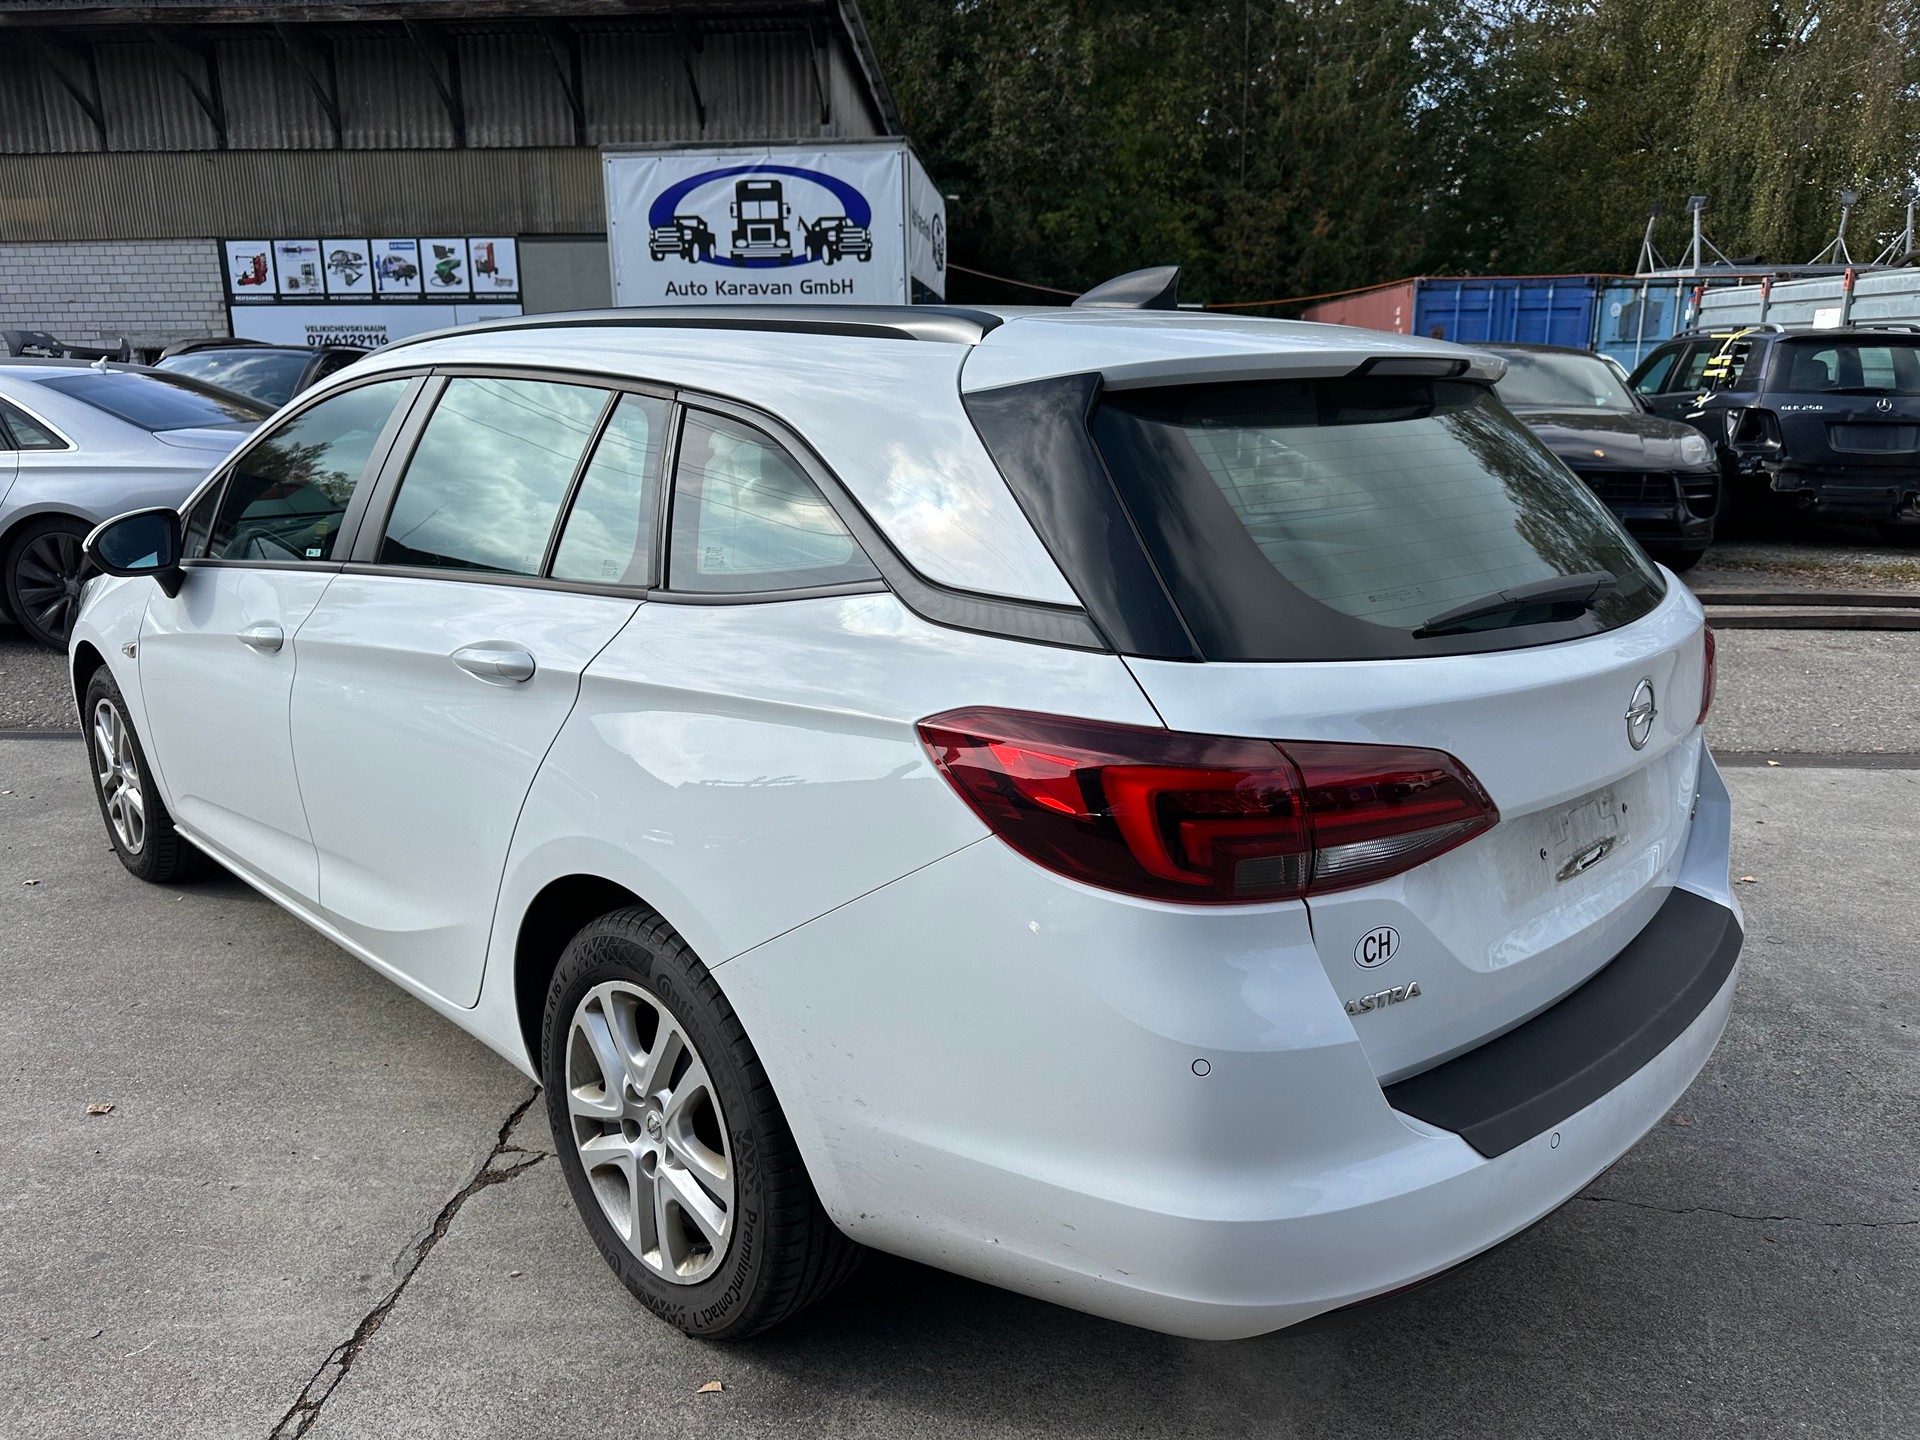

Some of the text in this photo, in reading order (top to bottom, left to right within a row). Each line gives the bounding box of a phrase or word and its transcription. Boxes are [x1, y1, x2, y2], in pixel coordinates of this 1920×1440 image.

[665, 278, 854, 297] Auto Karavan GmbH
[305, 324, 387, 333] VELIKICHEVSKI NAUM
[307, 333, 389, 346] 0766129116
[1363, 930, 1391, 963] CH
[1344, 980, 1421, 1016] ASTRA
[692, 1207, 759, 1329] PremiumContact 7
